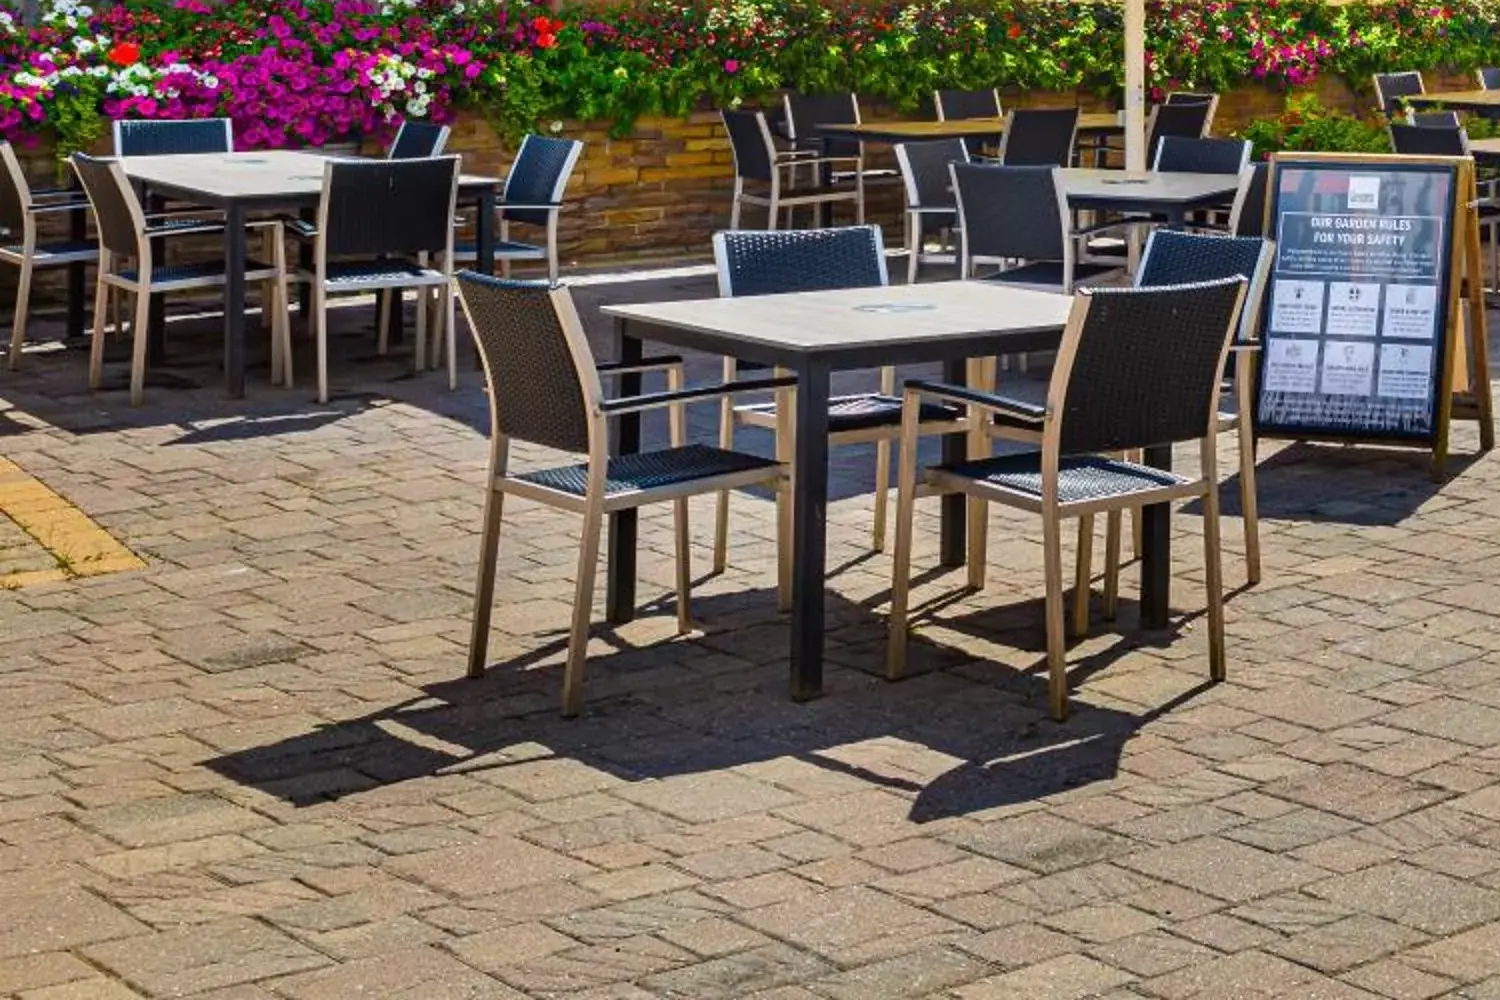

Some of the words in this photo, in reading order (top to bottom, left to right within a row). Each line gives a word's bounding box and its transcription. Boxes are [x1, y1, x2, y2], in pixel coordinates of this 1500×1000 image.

[1311, 216, 1333, 228] OUR
[1335, 217, 1377, 230] GARDEN
[1379, 219, 1411, 231] RULES
[1313, 231, 1335, 243] FOR
[1337, 233, 1365, 245] YOUR
[1367, 234, 1405, 247] SAFETY
